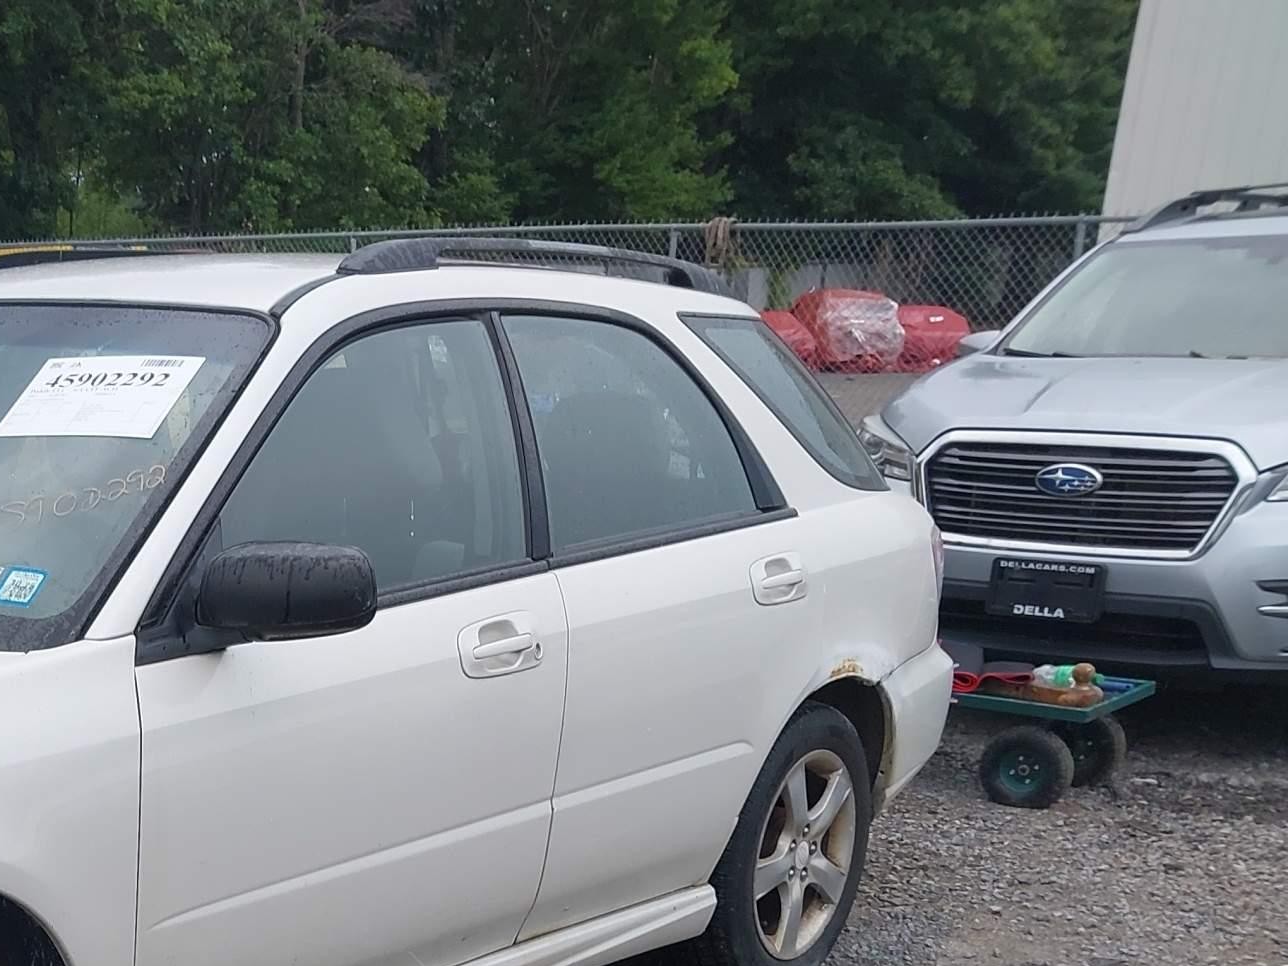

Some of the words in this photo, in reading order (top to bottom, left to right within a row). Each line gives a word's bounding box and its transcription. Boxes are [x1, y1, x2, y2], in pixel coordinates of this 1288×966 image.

[45, 371, 171, 388] 45902292
[999, 560, 1096, 574] DELLACARS.COM
[1012, 604, 1065, 619] DELLA
